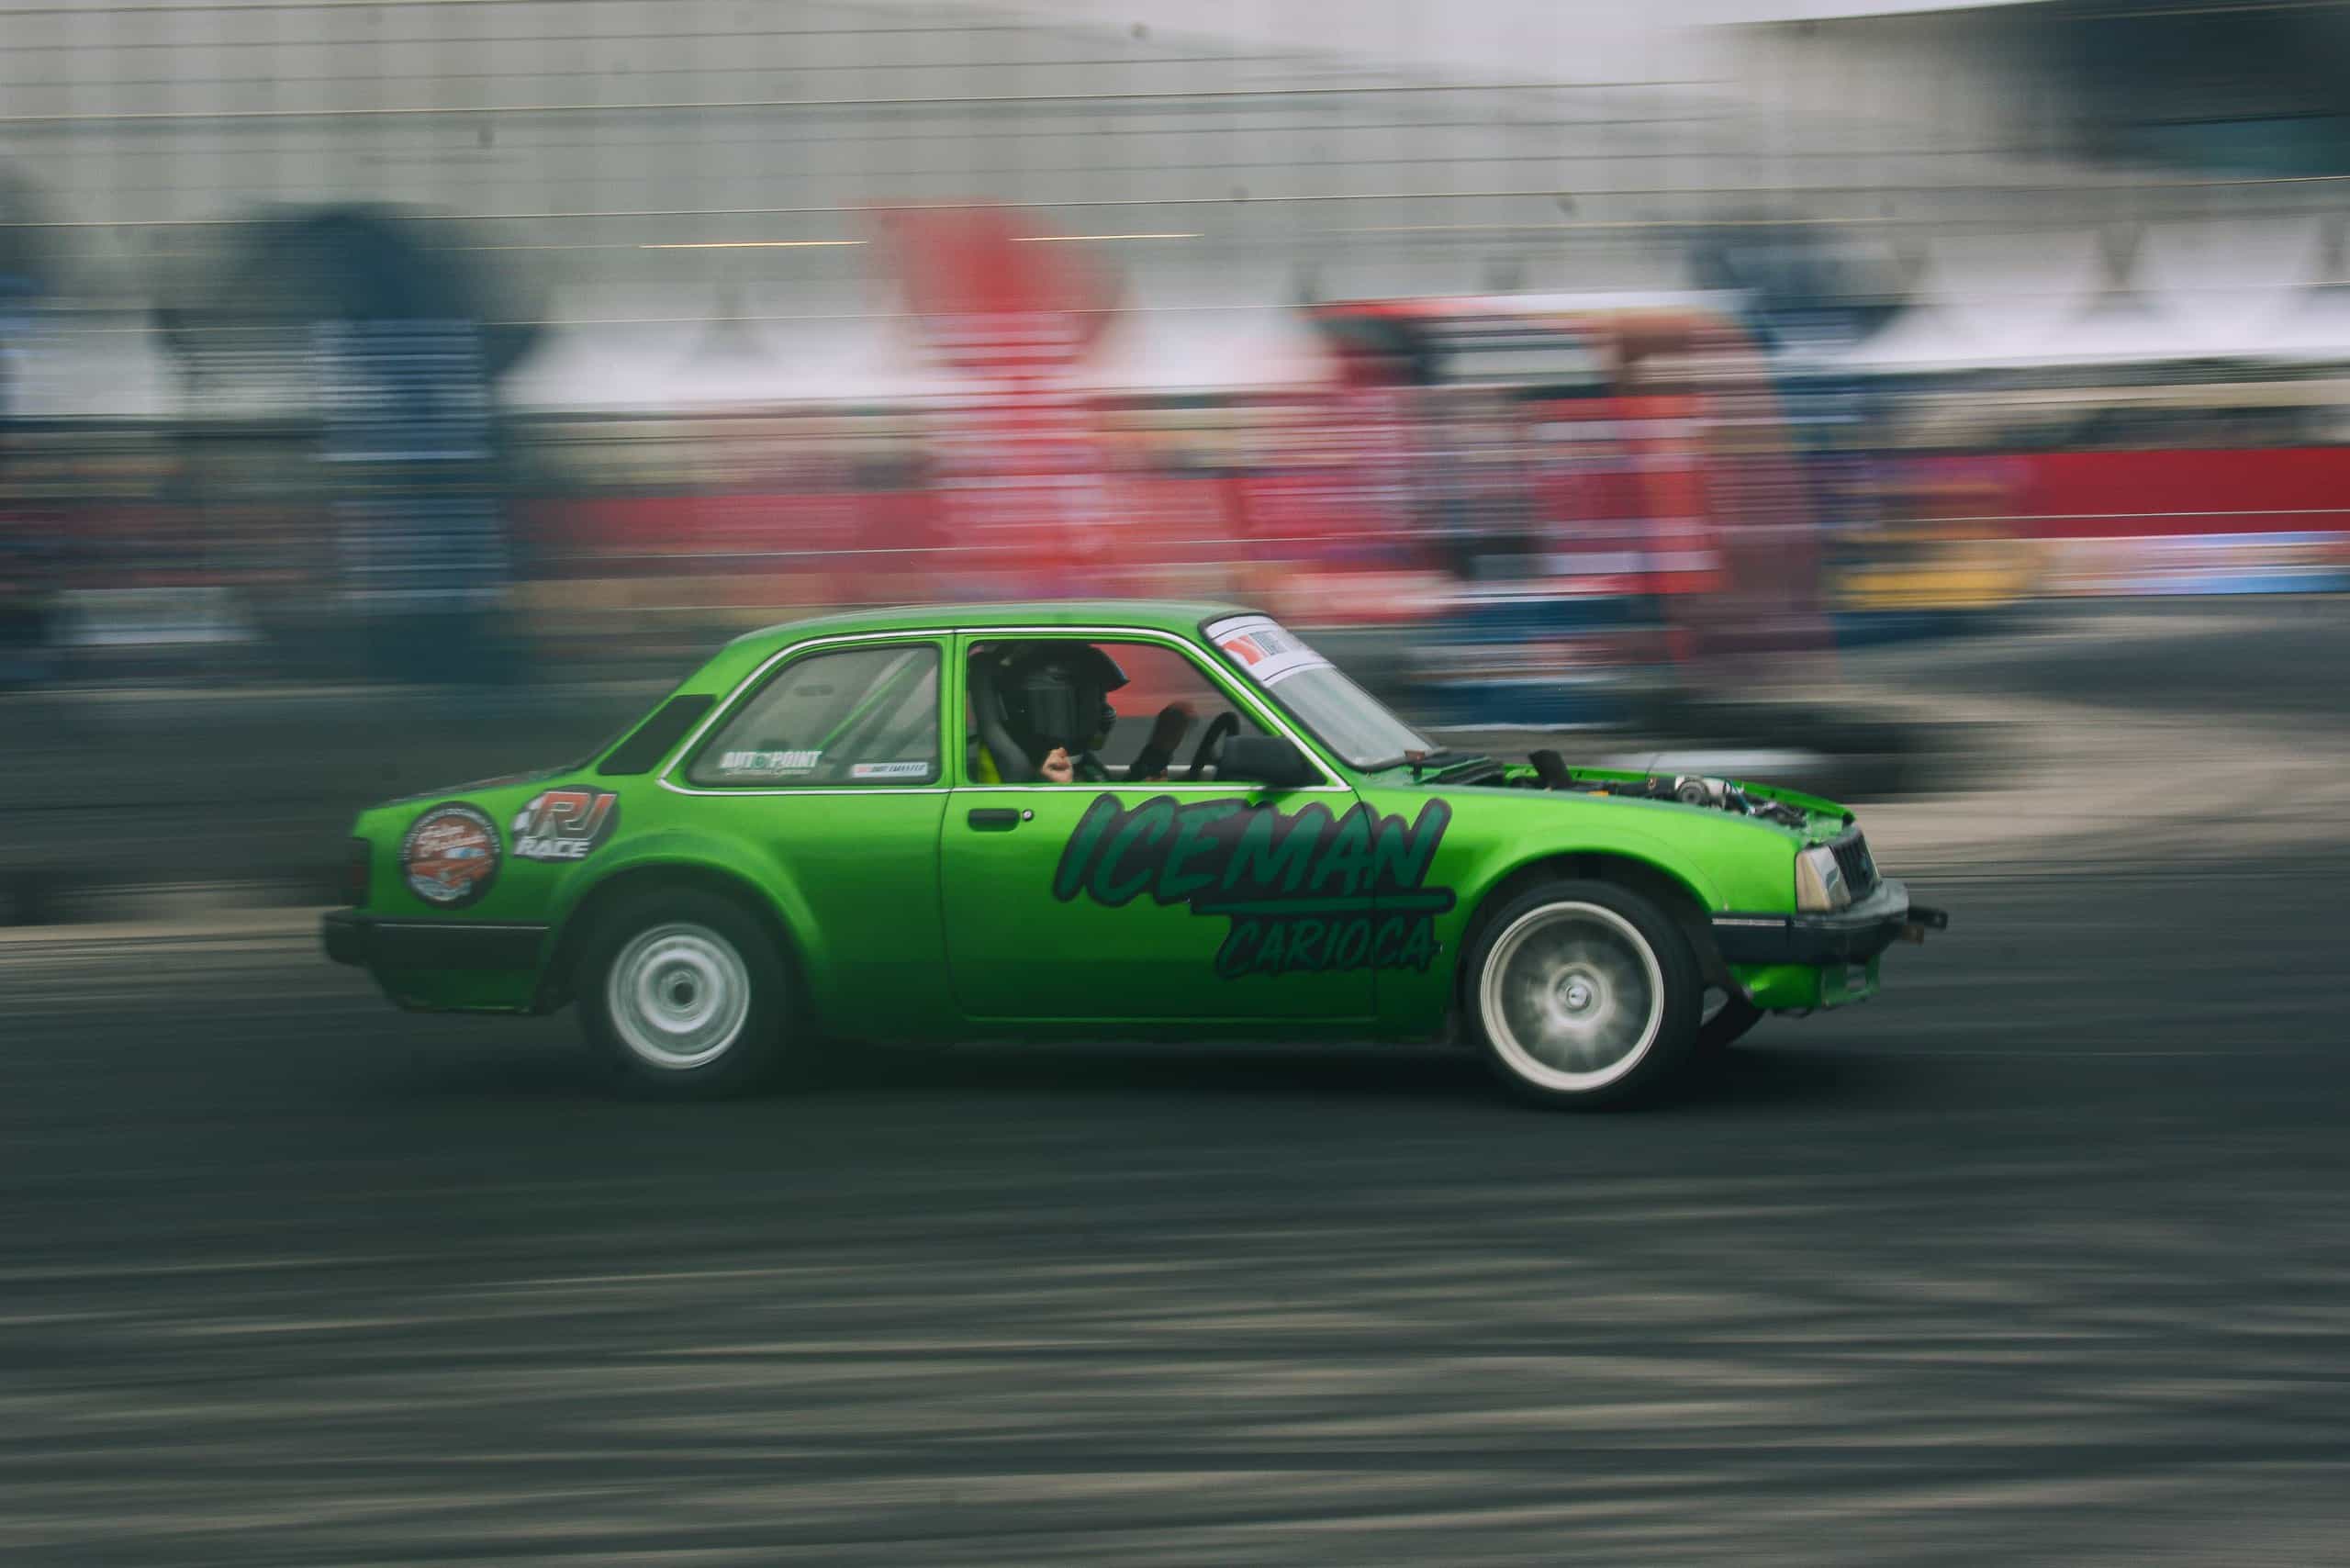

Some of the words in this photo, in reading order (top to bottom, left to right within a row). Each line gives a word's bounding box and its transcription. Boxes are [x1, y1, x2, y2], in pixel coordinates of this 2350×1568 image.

[514, 839, 591, 858] RACE
[1054, 793, 1452, 907] ICEMAN
[1216, 916, 1434, 979] CARIOCA
